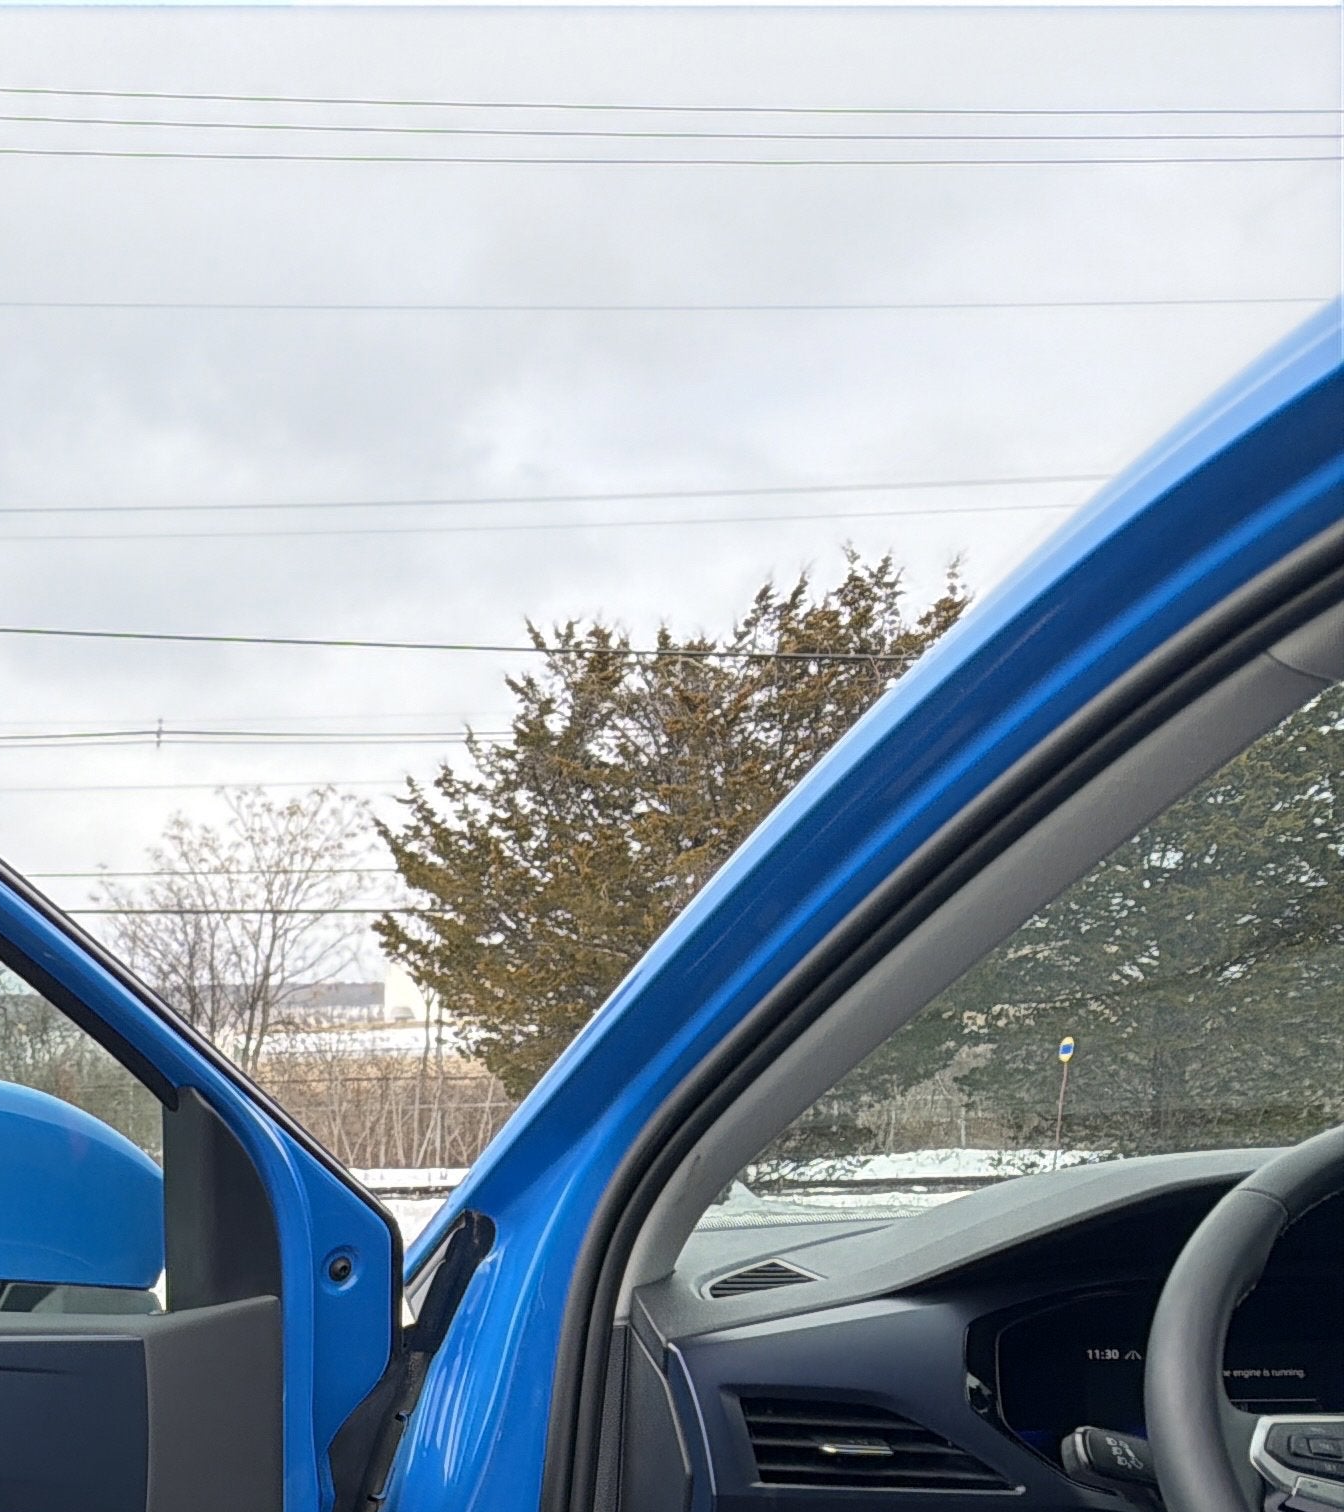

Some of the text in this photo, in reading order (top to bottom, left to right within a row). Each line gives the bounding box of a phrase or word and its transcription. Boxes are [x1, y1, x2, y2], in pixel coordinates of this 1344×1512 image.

[1086, 1349, 1119, 1360] 11:30
[1232, 1369, 1261, 1379] engine
[1263, 1368, 1270, 1377] is
